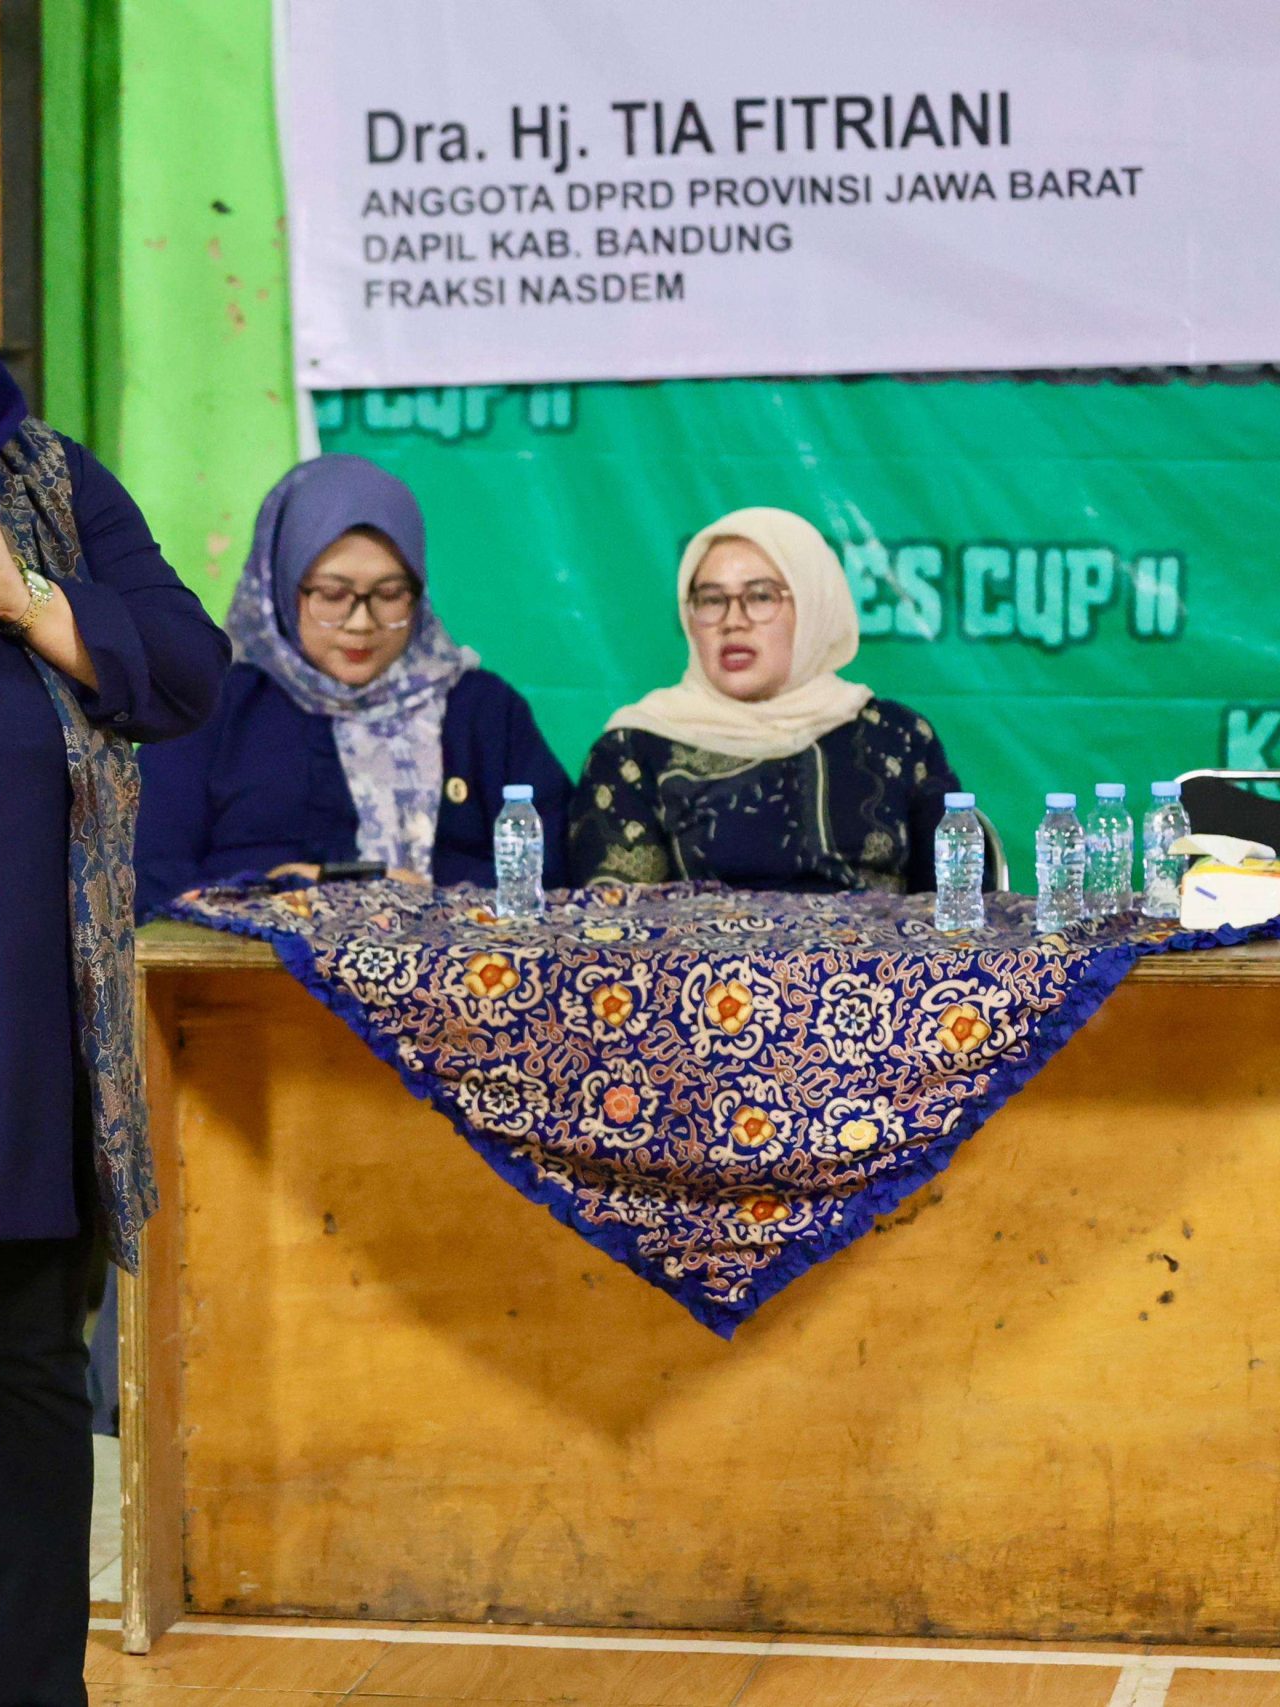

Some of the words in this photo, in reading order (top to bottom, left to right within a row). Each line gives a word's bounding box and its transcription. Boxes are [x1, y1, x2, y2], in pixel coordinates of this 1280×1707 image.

[366, 109, 487, 165] Dra.
[510, 103, 589, 175] Hj.
[610, 98, 716, 158] TIA
[733, 90, 1011, 155] FITRIANI
[362, 184, 555, 218] ANGGOTA
[566, 179, 675, 213] DPRD
[688, 174, 872, 209] PROVINSI
[885, 170, 997, 204] JAWA
[1008, 166, 1145, 201] BARAT
[364, 232, 476, 263] DAPIL
[490, 228, 583, 260] KAB.
[595, 221, 793, 258] BANDUNG
[365, 277, 505, 308] FRAKSI
[519, 271, 685, 305] NASDEM
[842, 541, 942, 639] ES
[963, 545, 1114, 646] CUP
